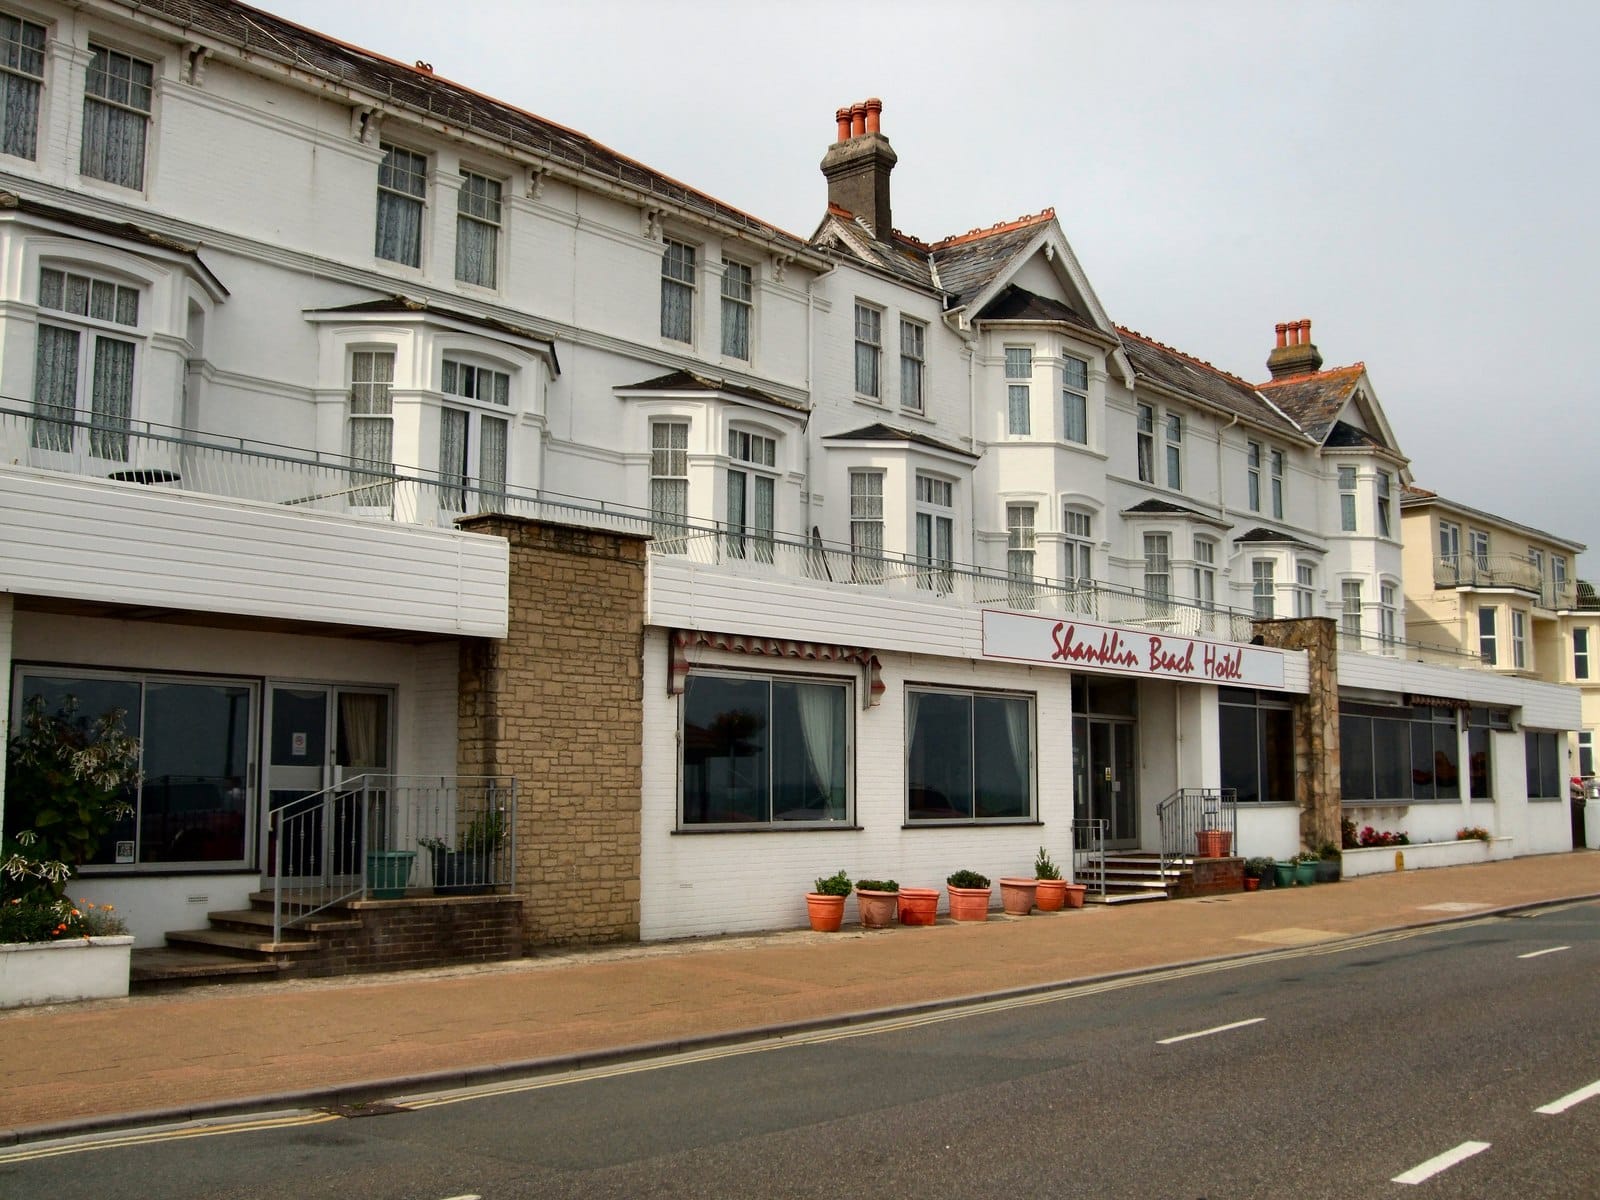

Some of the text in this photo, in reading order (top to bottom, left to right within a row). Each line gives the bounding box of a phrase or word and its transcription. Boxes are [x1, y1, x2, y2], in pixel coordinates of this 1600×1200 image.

[1052, 622, 1242, 680] Shanklin Beach Hotel
